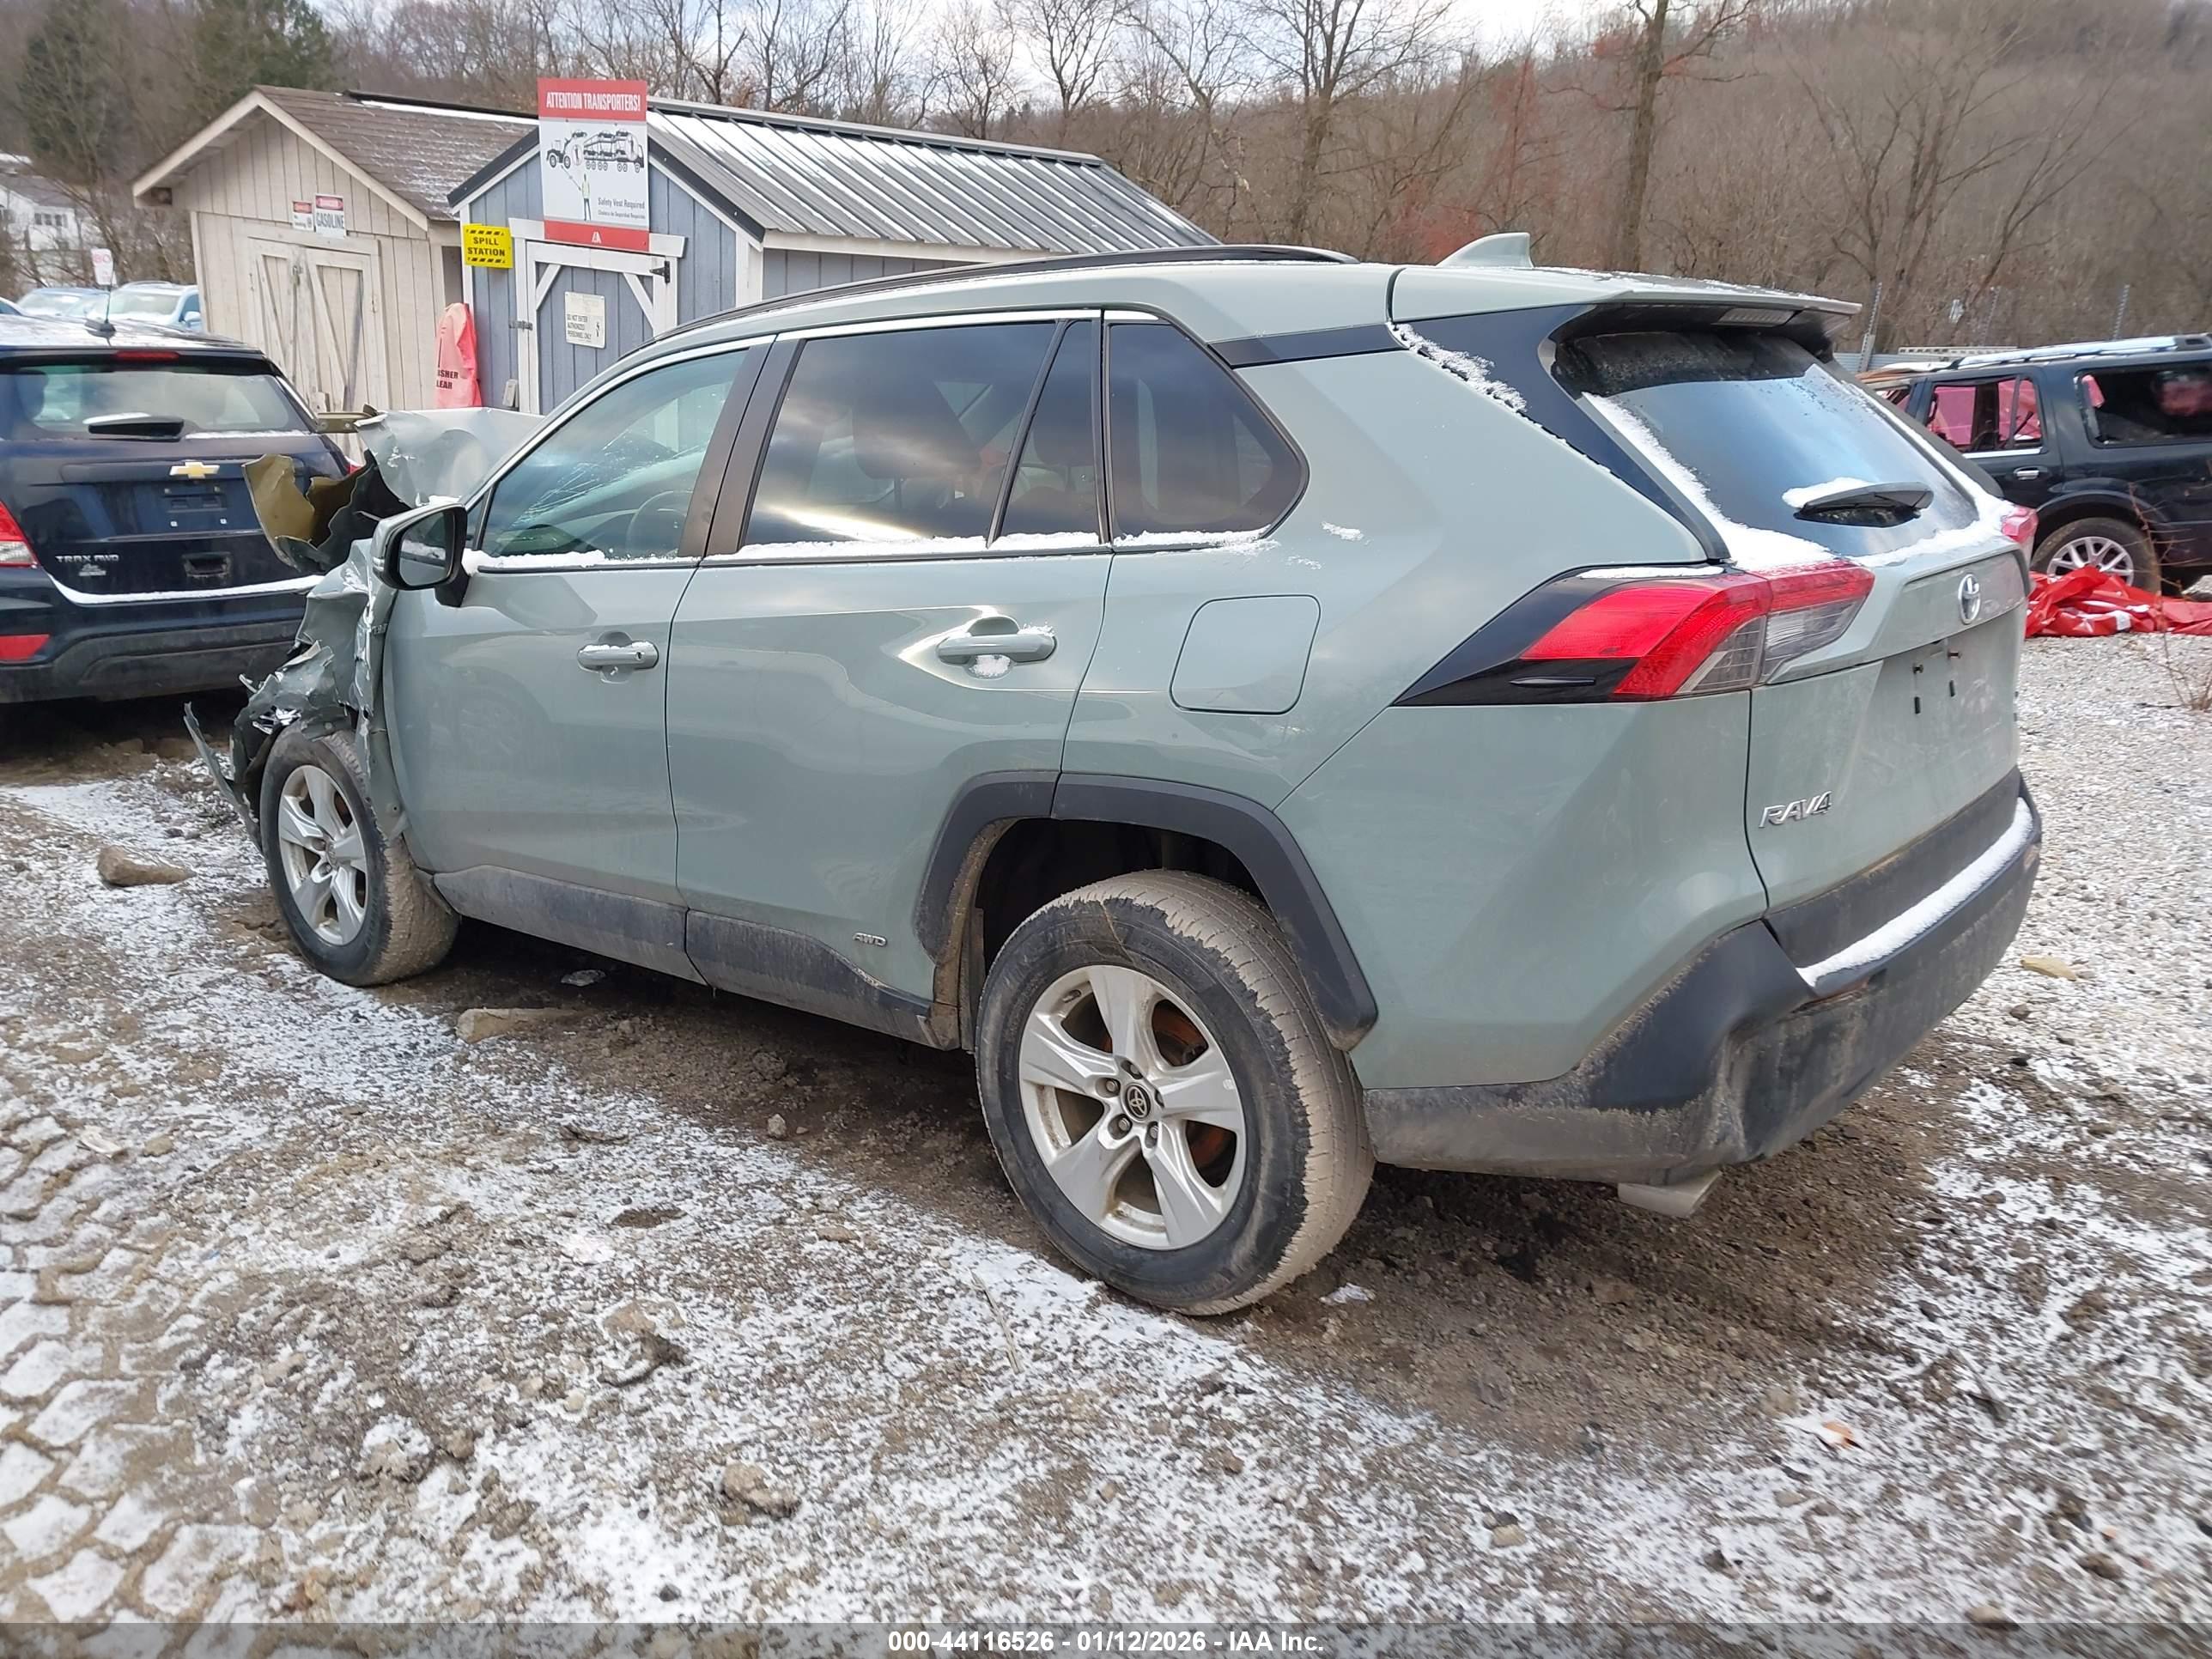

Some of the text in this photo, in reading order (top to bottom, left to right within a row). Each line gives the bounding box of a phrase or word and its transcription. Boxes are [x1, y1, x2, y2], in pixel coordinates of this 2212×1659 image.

[546, 92, 641, 111] ATTENTION TRANSPORTERS!
[598, 198, 612, 208] Safety
[624, 199, 645, 210] Required
[316, 212, 344, 229] GASOLINE
[473, 236, 499, 246] SPILL
[467, 246, 506, 257] STATION
[55, 554, 119, 563] TRAX AWD
[1758, 790, 1832, 829] RAV4
[852, 932, 887, 947] AWD
